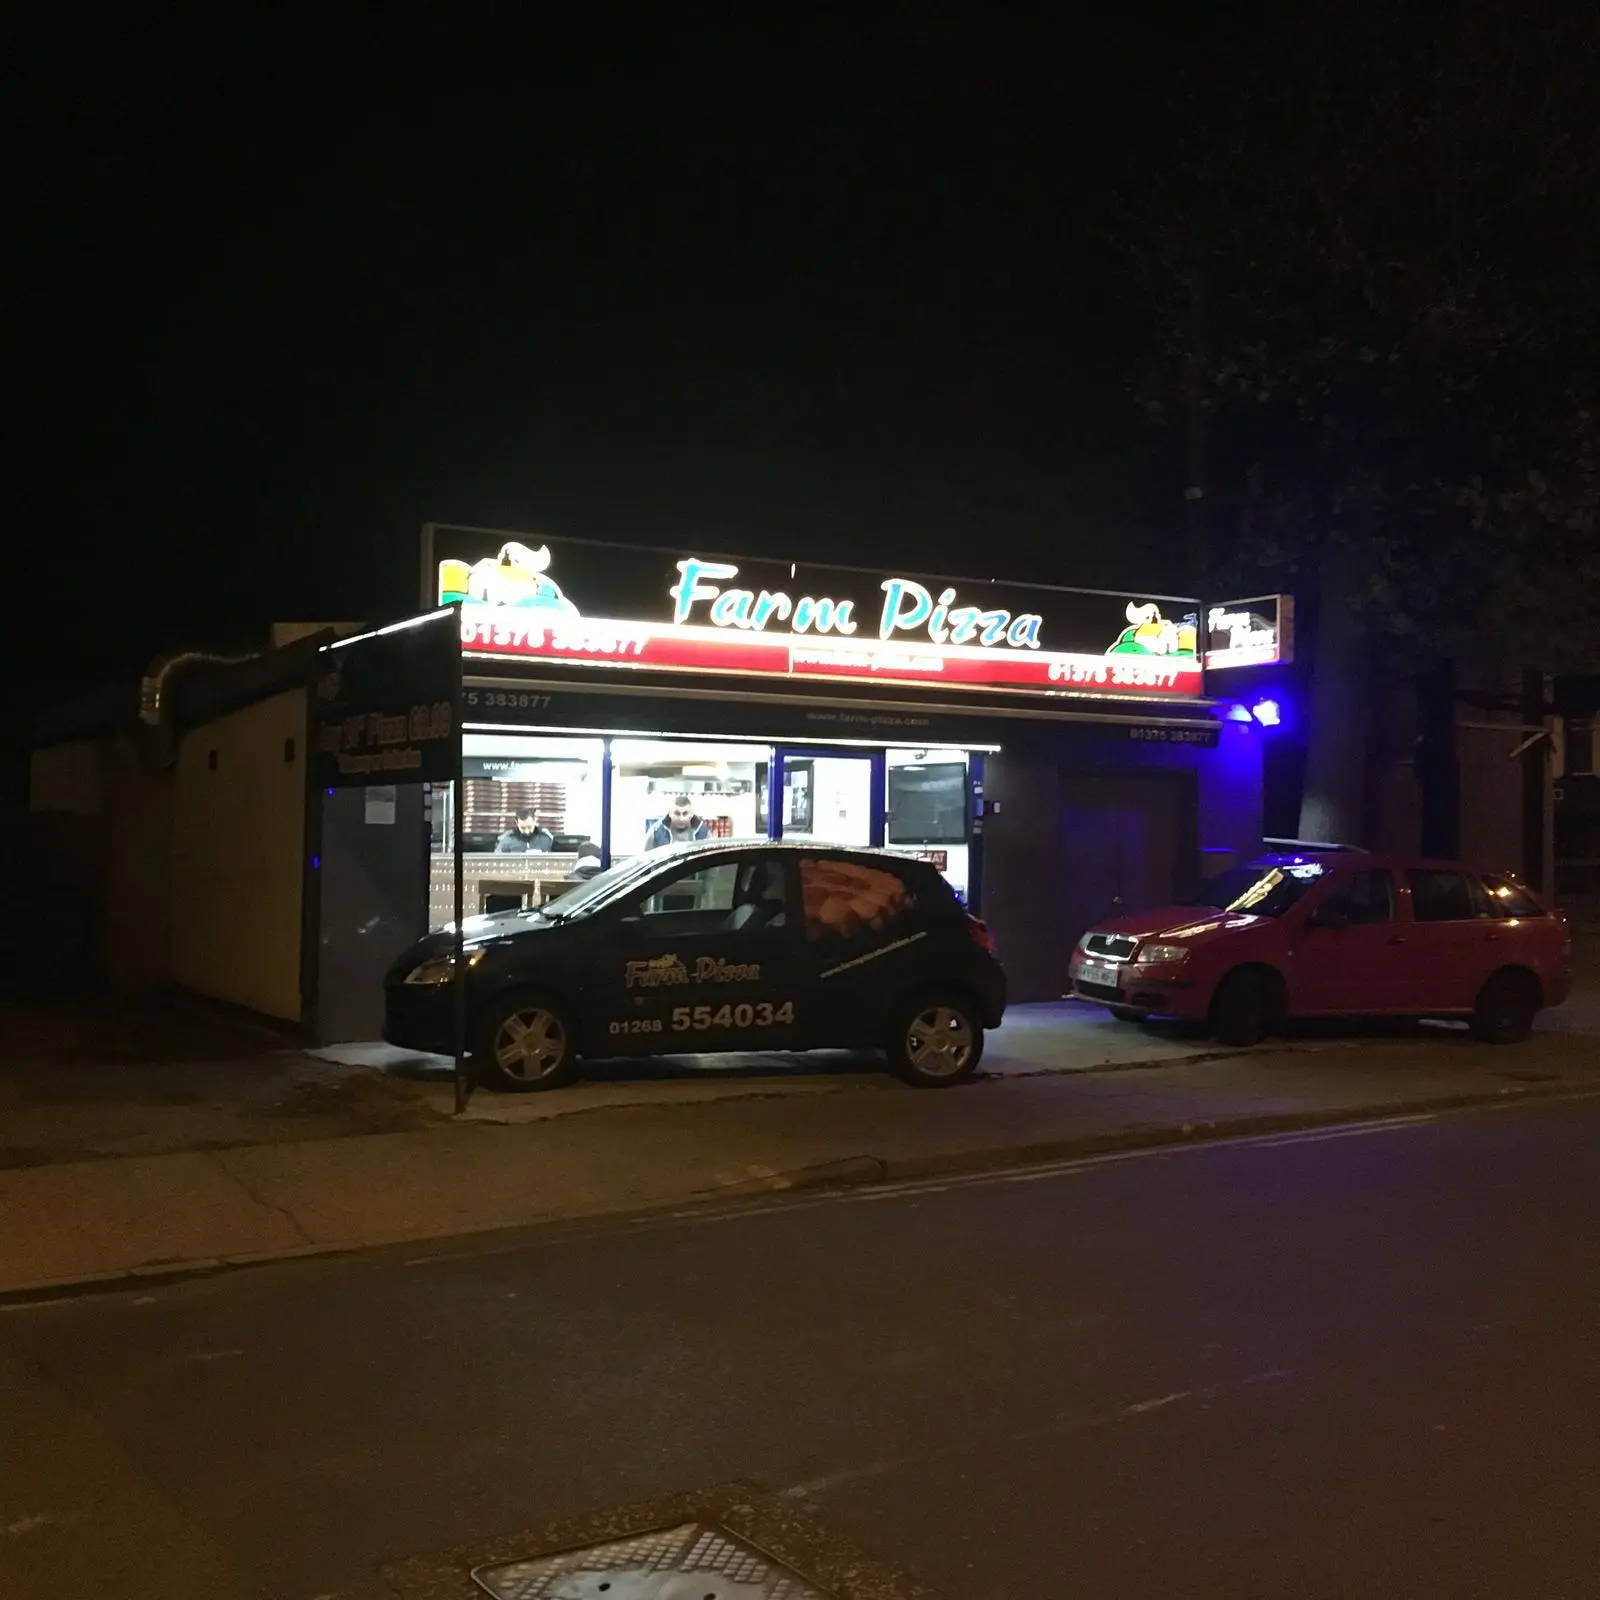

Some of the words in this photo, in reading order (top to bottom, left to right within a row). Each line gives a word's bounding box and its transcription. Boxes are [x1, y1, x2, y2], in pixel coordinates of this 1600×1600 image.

[670, 557, 857, 637] Farm
[880, 577, 1043, 650] Pizza
[484, 693, 551, 709] 383877
[608, 1019, 663, 1035] 01268
[671, 1001, 795, 1031] 554034
